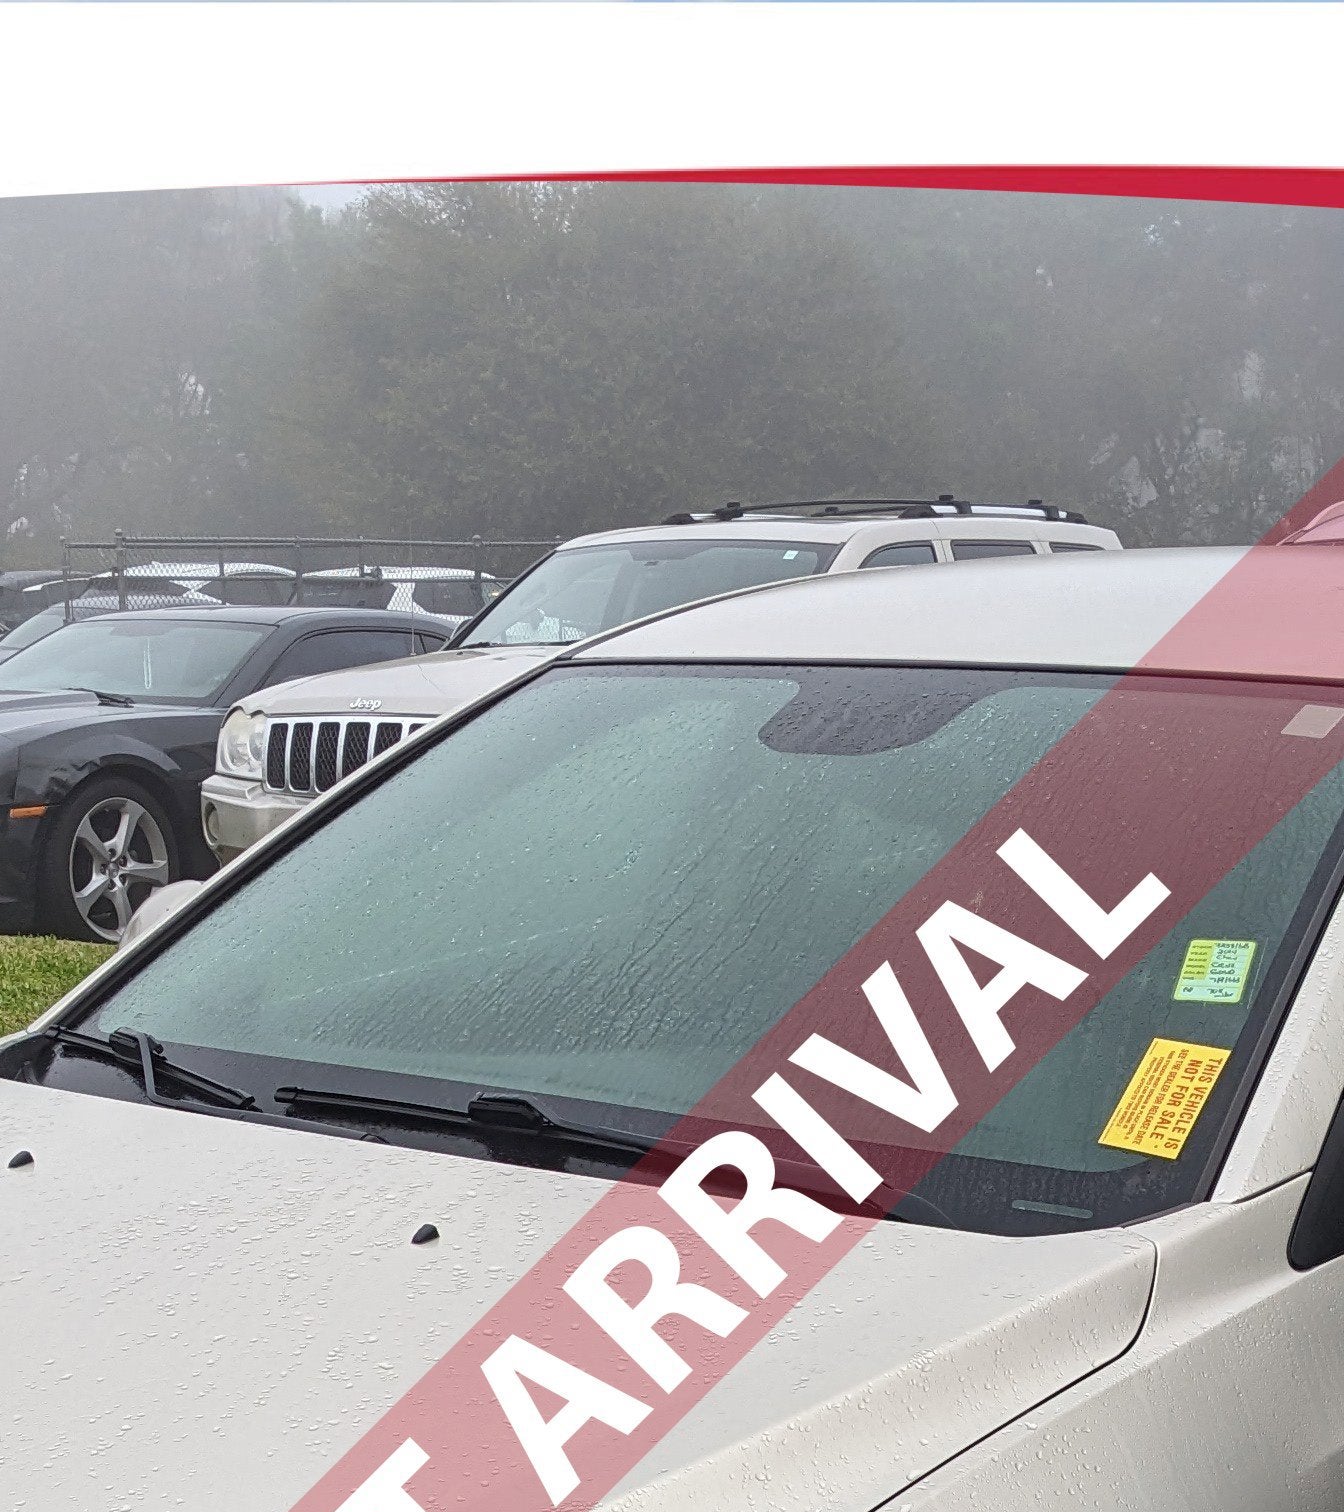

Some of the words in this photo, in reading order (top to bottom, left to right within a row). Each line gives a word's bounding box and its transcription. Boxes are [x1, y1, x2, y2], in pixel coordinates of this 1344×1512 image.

[349, 697, 383, 711] Jeep
[1179, 1059, 1203, 1082] NOT
[1197, 1056, 1223, 1083] THIS
[1166, 1084, 1189, 1107] FOR
[1139, 1104, 1159, 1130] RELEASE
[1171, 1085, 1208, 1134] VEHICLE
[1149, 1109, 1176, 1140] SALE
[1131, 1130, 1146, 1145] DATE
[1163, 1137, 1181, 1150] IS
